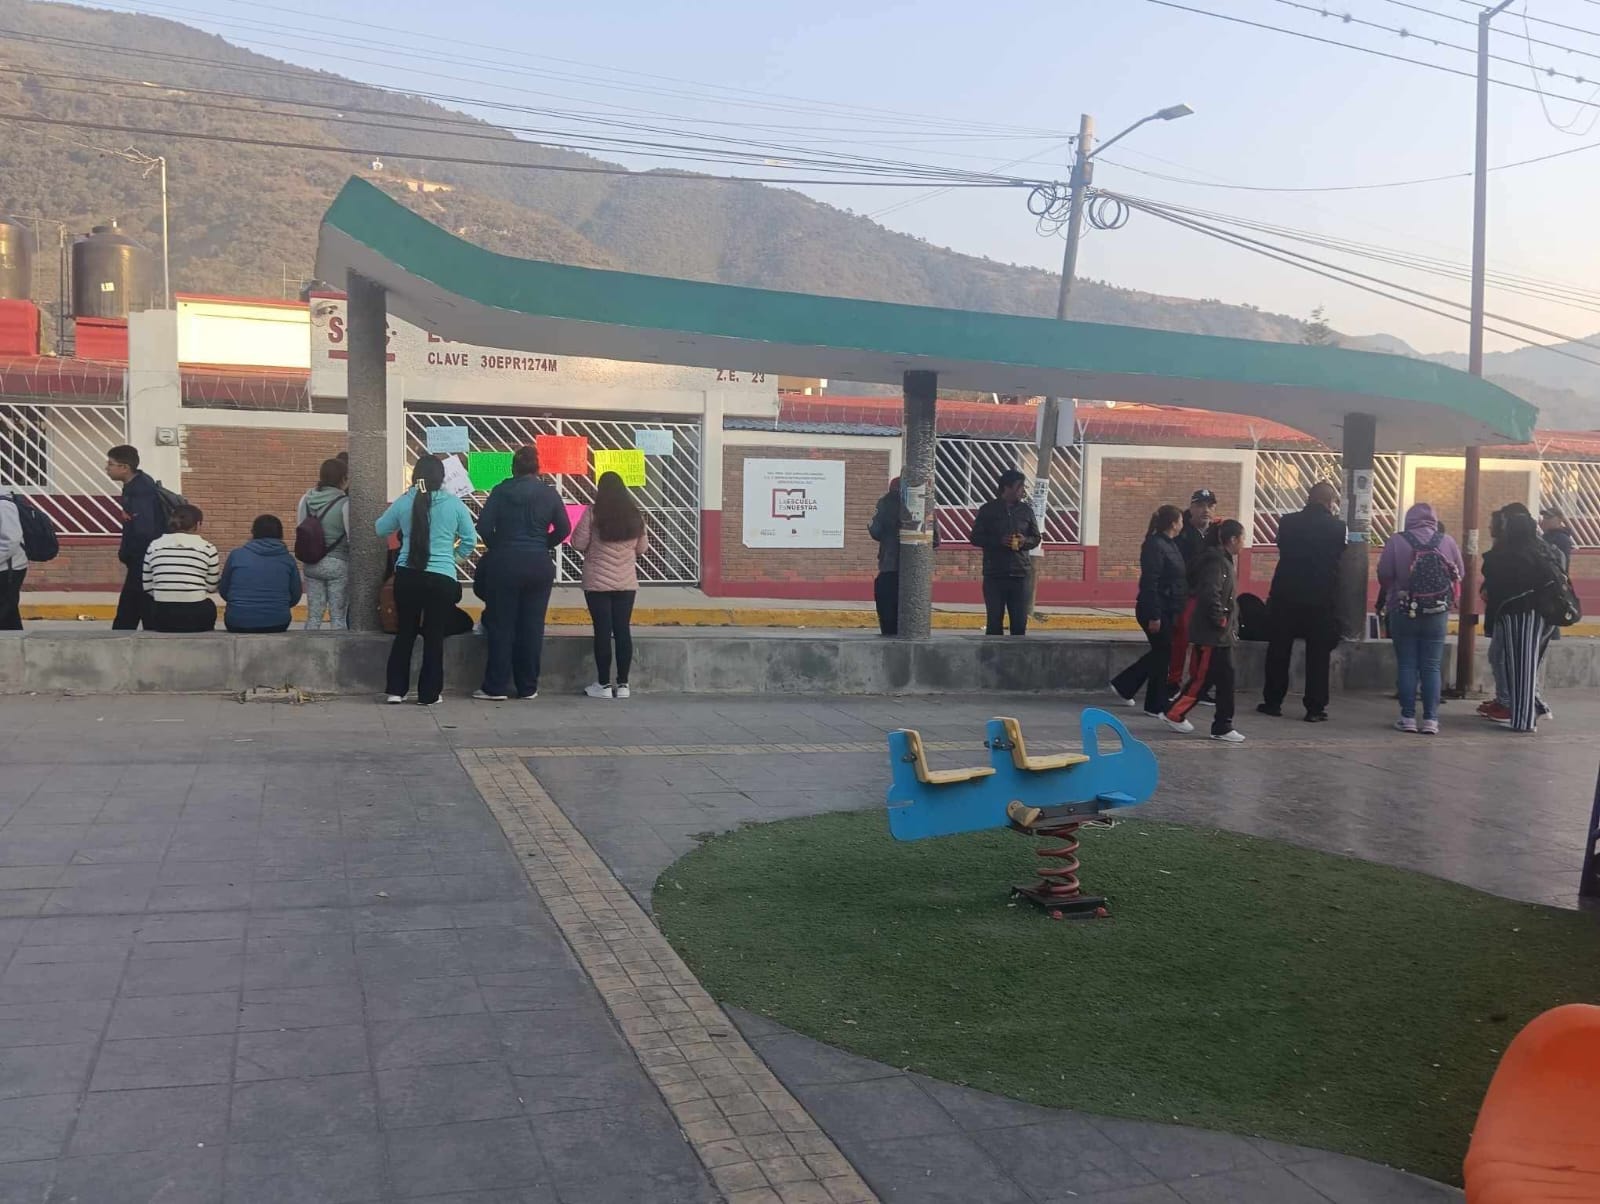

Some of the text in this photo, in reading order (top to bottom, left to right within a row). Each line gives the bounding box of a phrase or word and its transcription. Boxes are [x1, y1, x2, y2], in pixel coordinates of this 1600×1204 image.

[428, 352, 557, 372] CLAVE 30EPR1274M
[751, 371, 765, 383] 23
